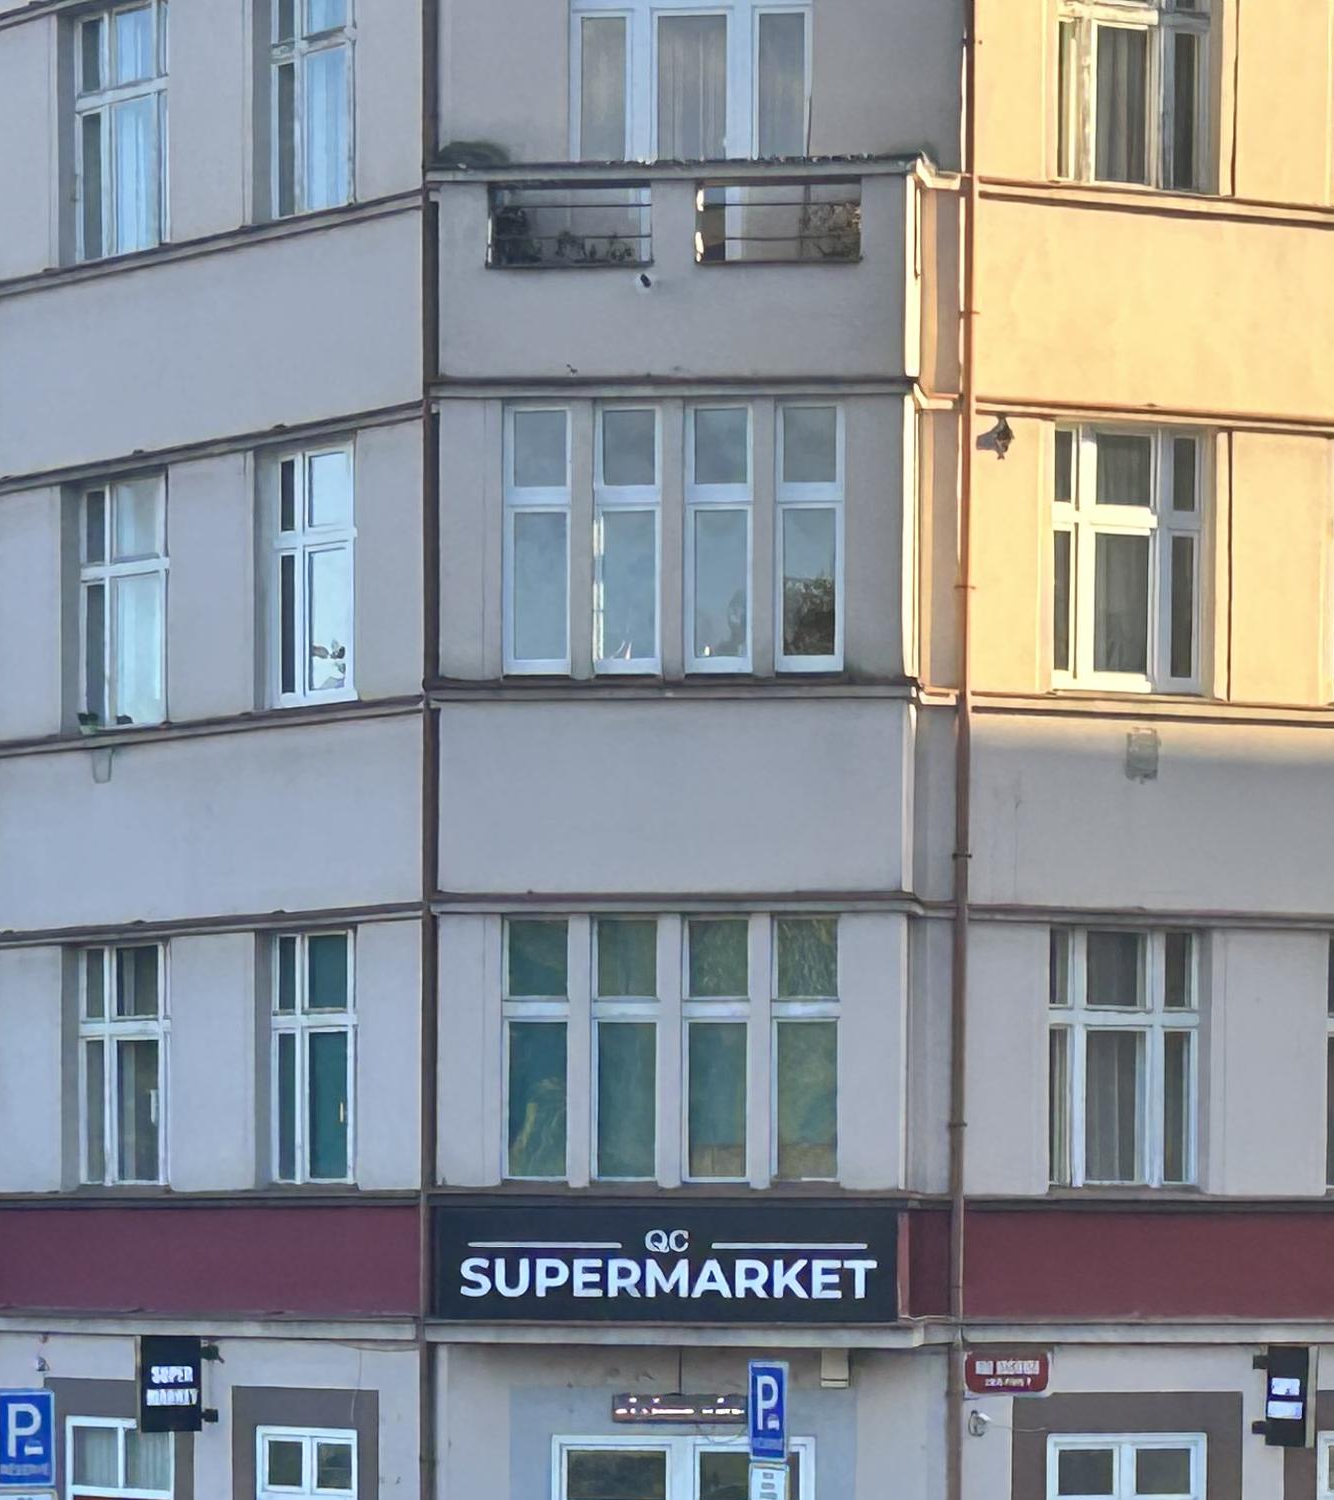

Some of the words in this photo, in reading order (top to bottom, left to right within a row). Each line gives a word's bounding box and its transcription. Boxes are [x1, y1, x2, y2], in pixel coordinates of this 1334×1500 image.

[644, 1229, 690, 1253] QC
[459, 1257, 878, 1299] SUPERMARKET
[756, 1375, 779, 1431] P
[7, 1403, 42, 1458] P
